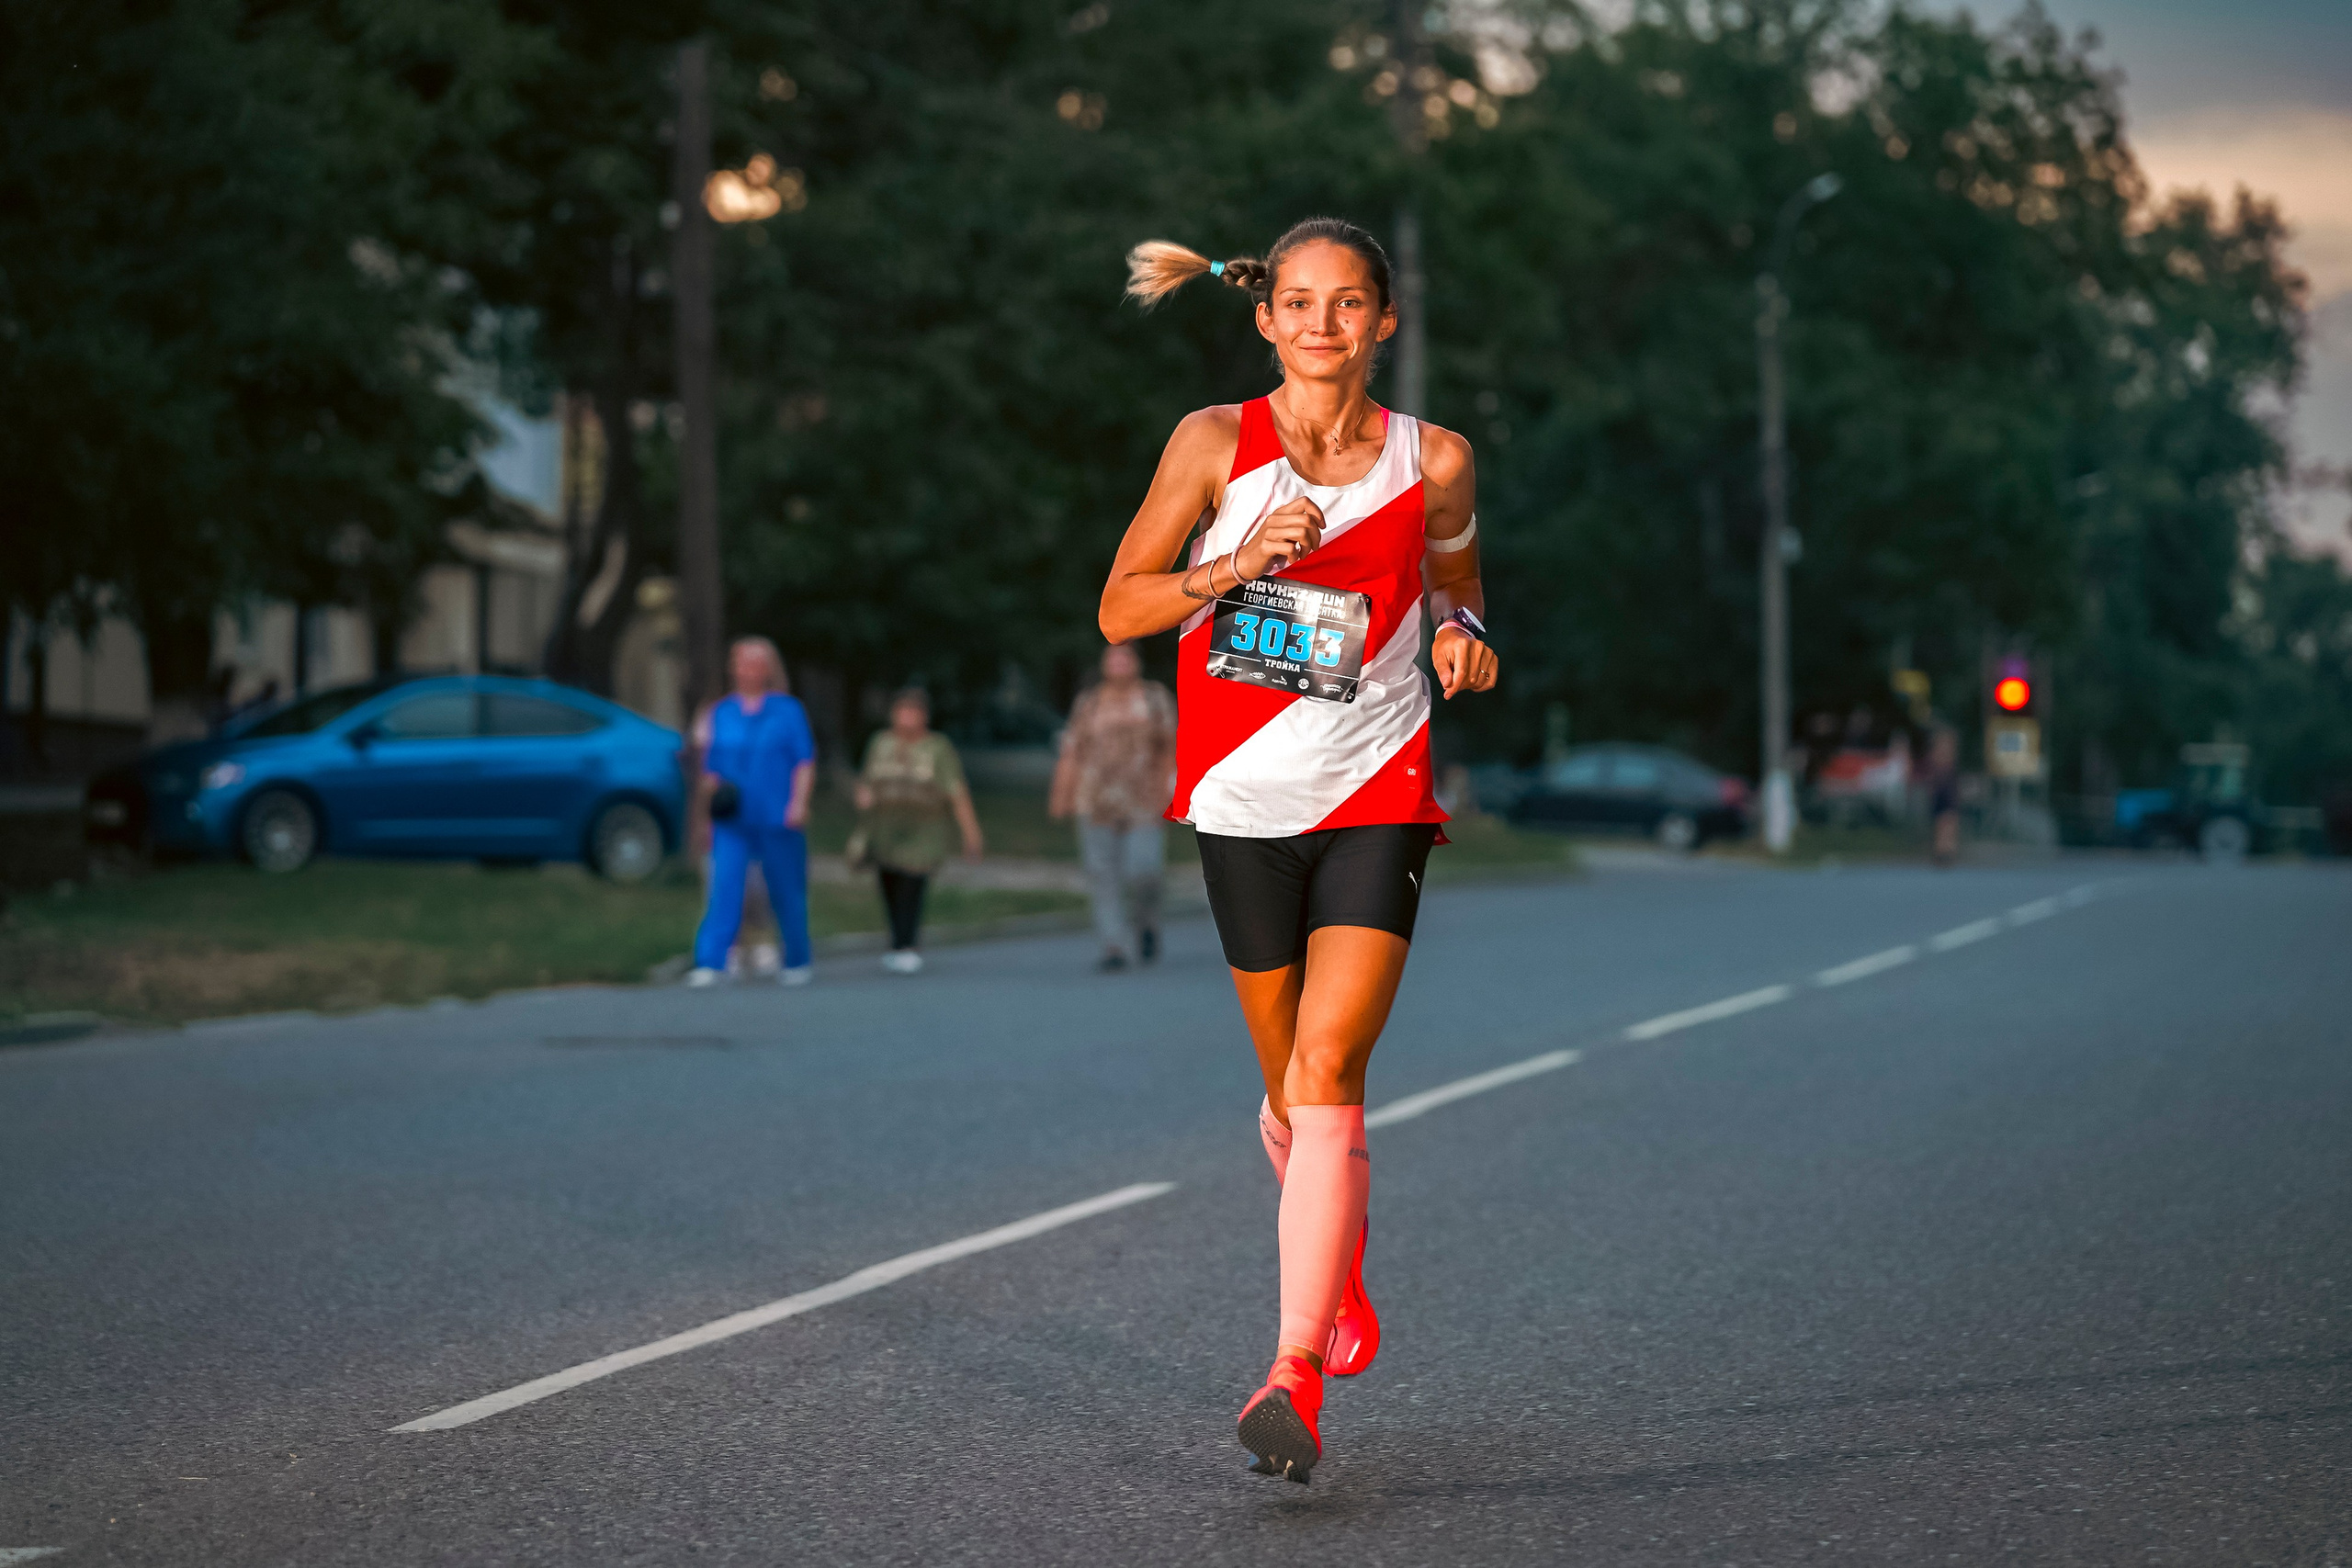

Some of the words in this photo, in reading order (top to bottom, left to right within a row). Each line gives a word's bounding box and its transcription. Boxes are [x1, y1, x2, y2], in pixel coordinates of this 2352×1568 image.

[1243, 591, 1305, 612] ГЕОРГИЕВСКАЯ
[1231, 612, 1345, 667] 3033
[1264, 659, 1301, 672] ТРОЙКА
